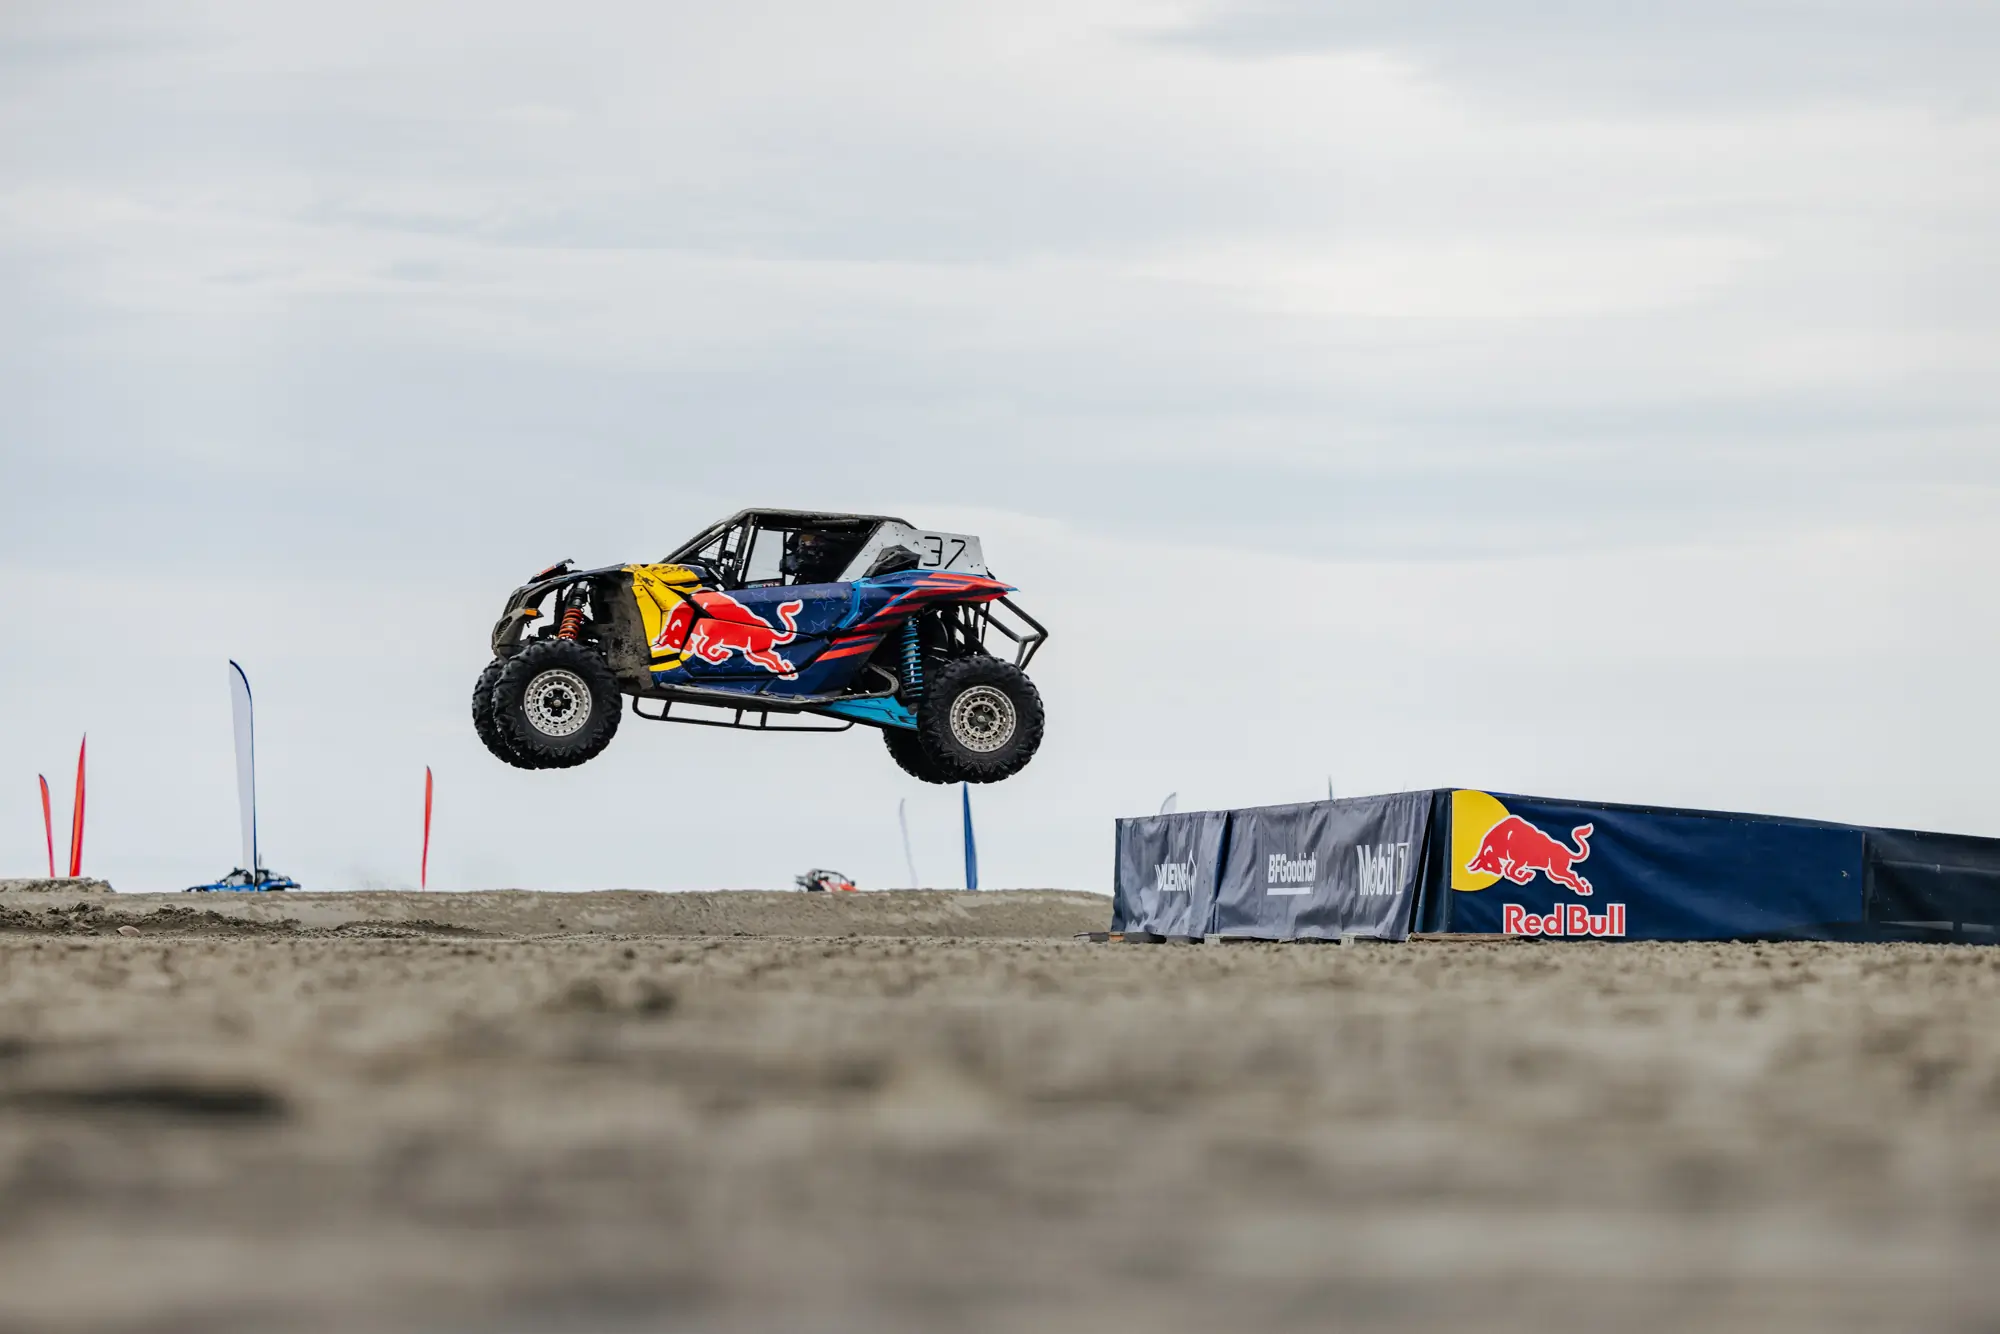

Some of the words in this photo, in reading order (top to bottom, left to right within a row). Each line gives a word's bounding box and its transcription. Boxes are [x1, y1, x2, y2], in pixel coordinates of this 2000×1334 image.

[923, 535, 966, 570] 37
[1356, 843, 1394, 896] Mobil
[1503, 903, 1564, 936] Red
[1566, 904, 1626, 937] Bull
